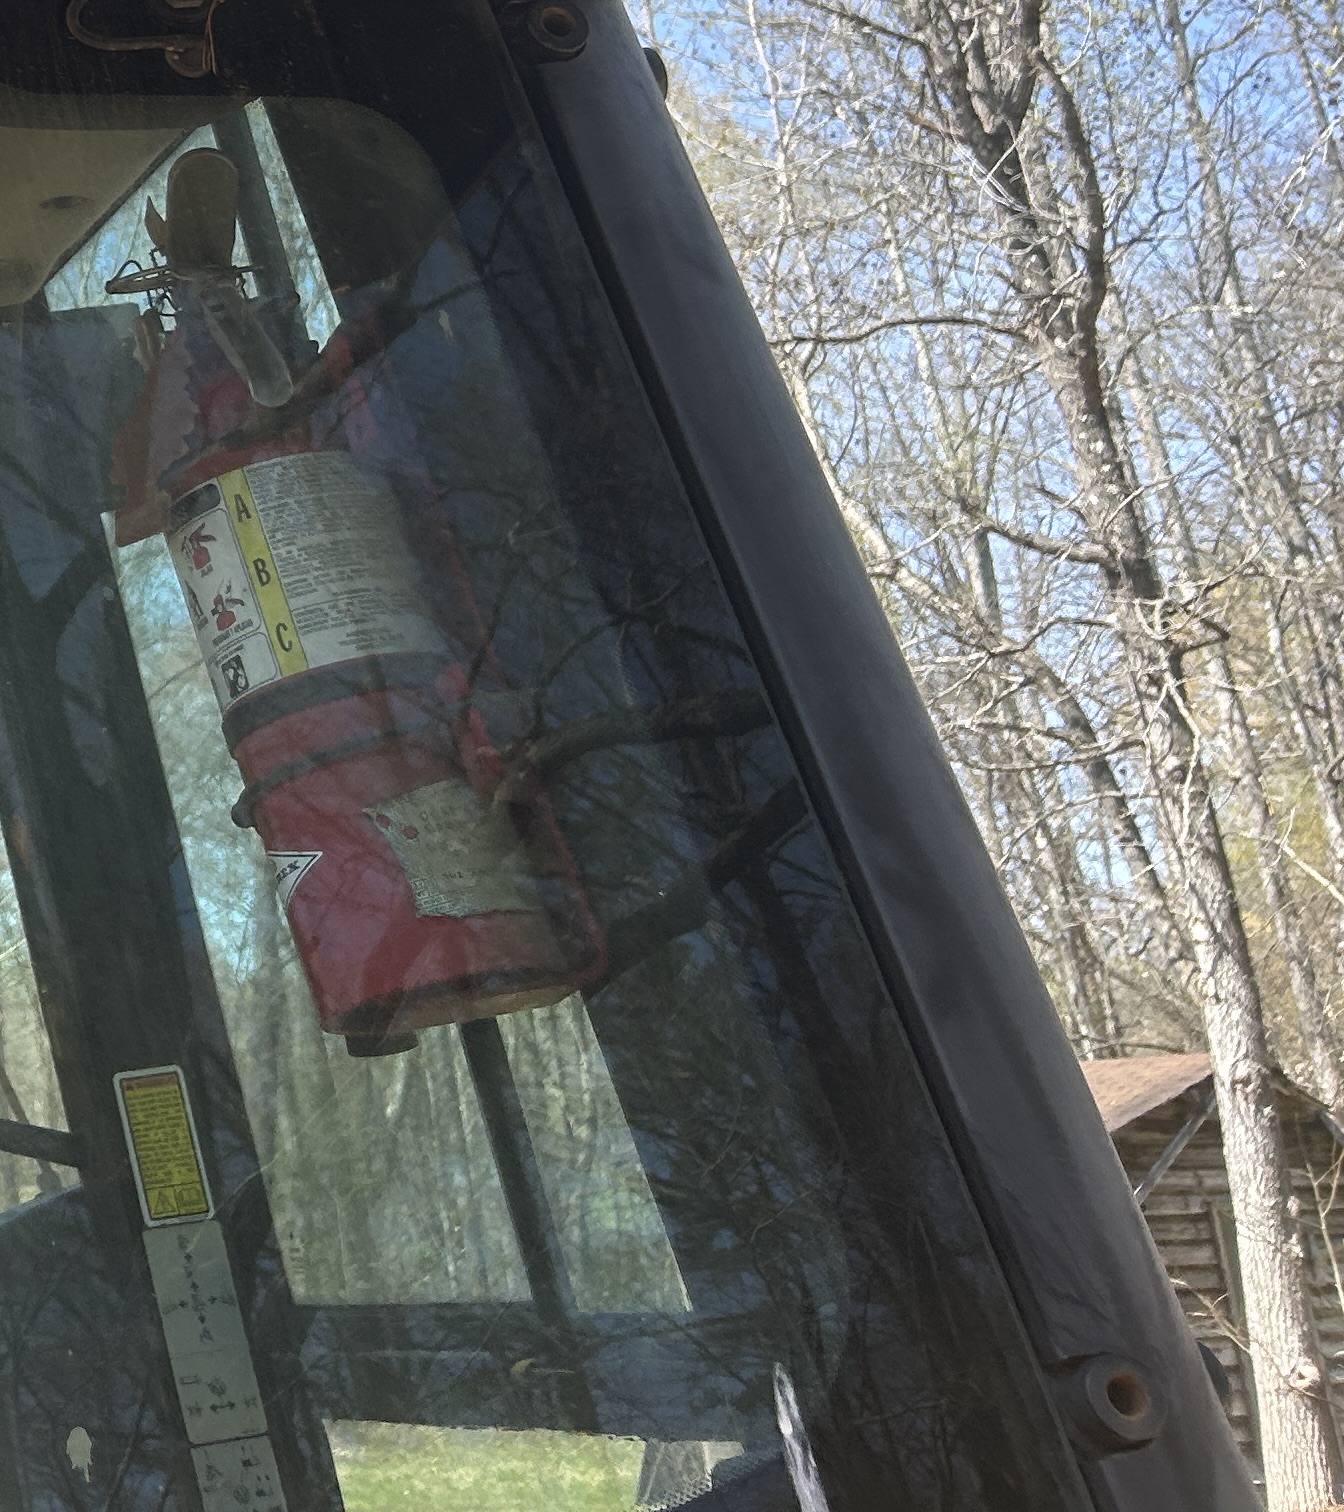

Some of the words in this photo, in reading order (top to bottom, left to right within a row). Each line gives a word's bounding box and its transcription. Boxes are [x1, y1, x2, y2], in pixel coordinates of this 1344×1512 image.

[233, 494, 251, 522] A
[253, 558, 270, 587] B
[276, 623, 292, 652] C
